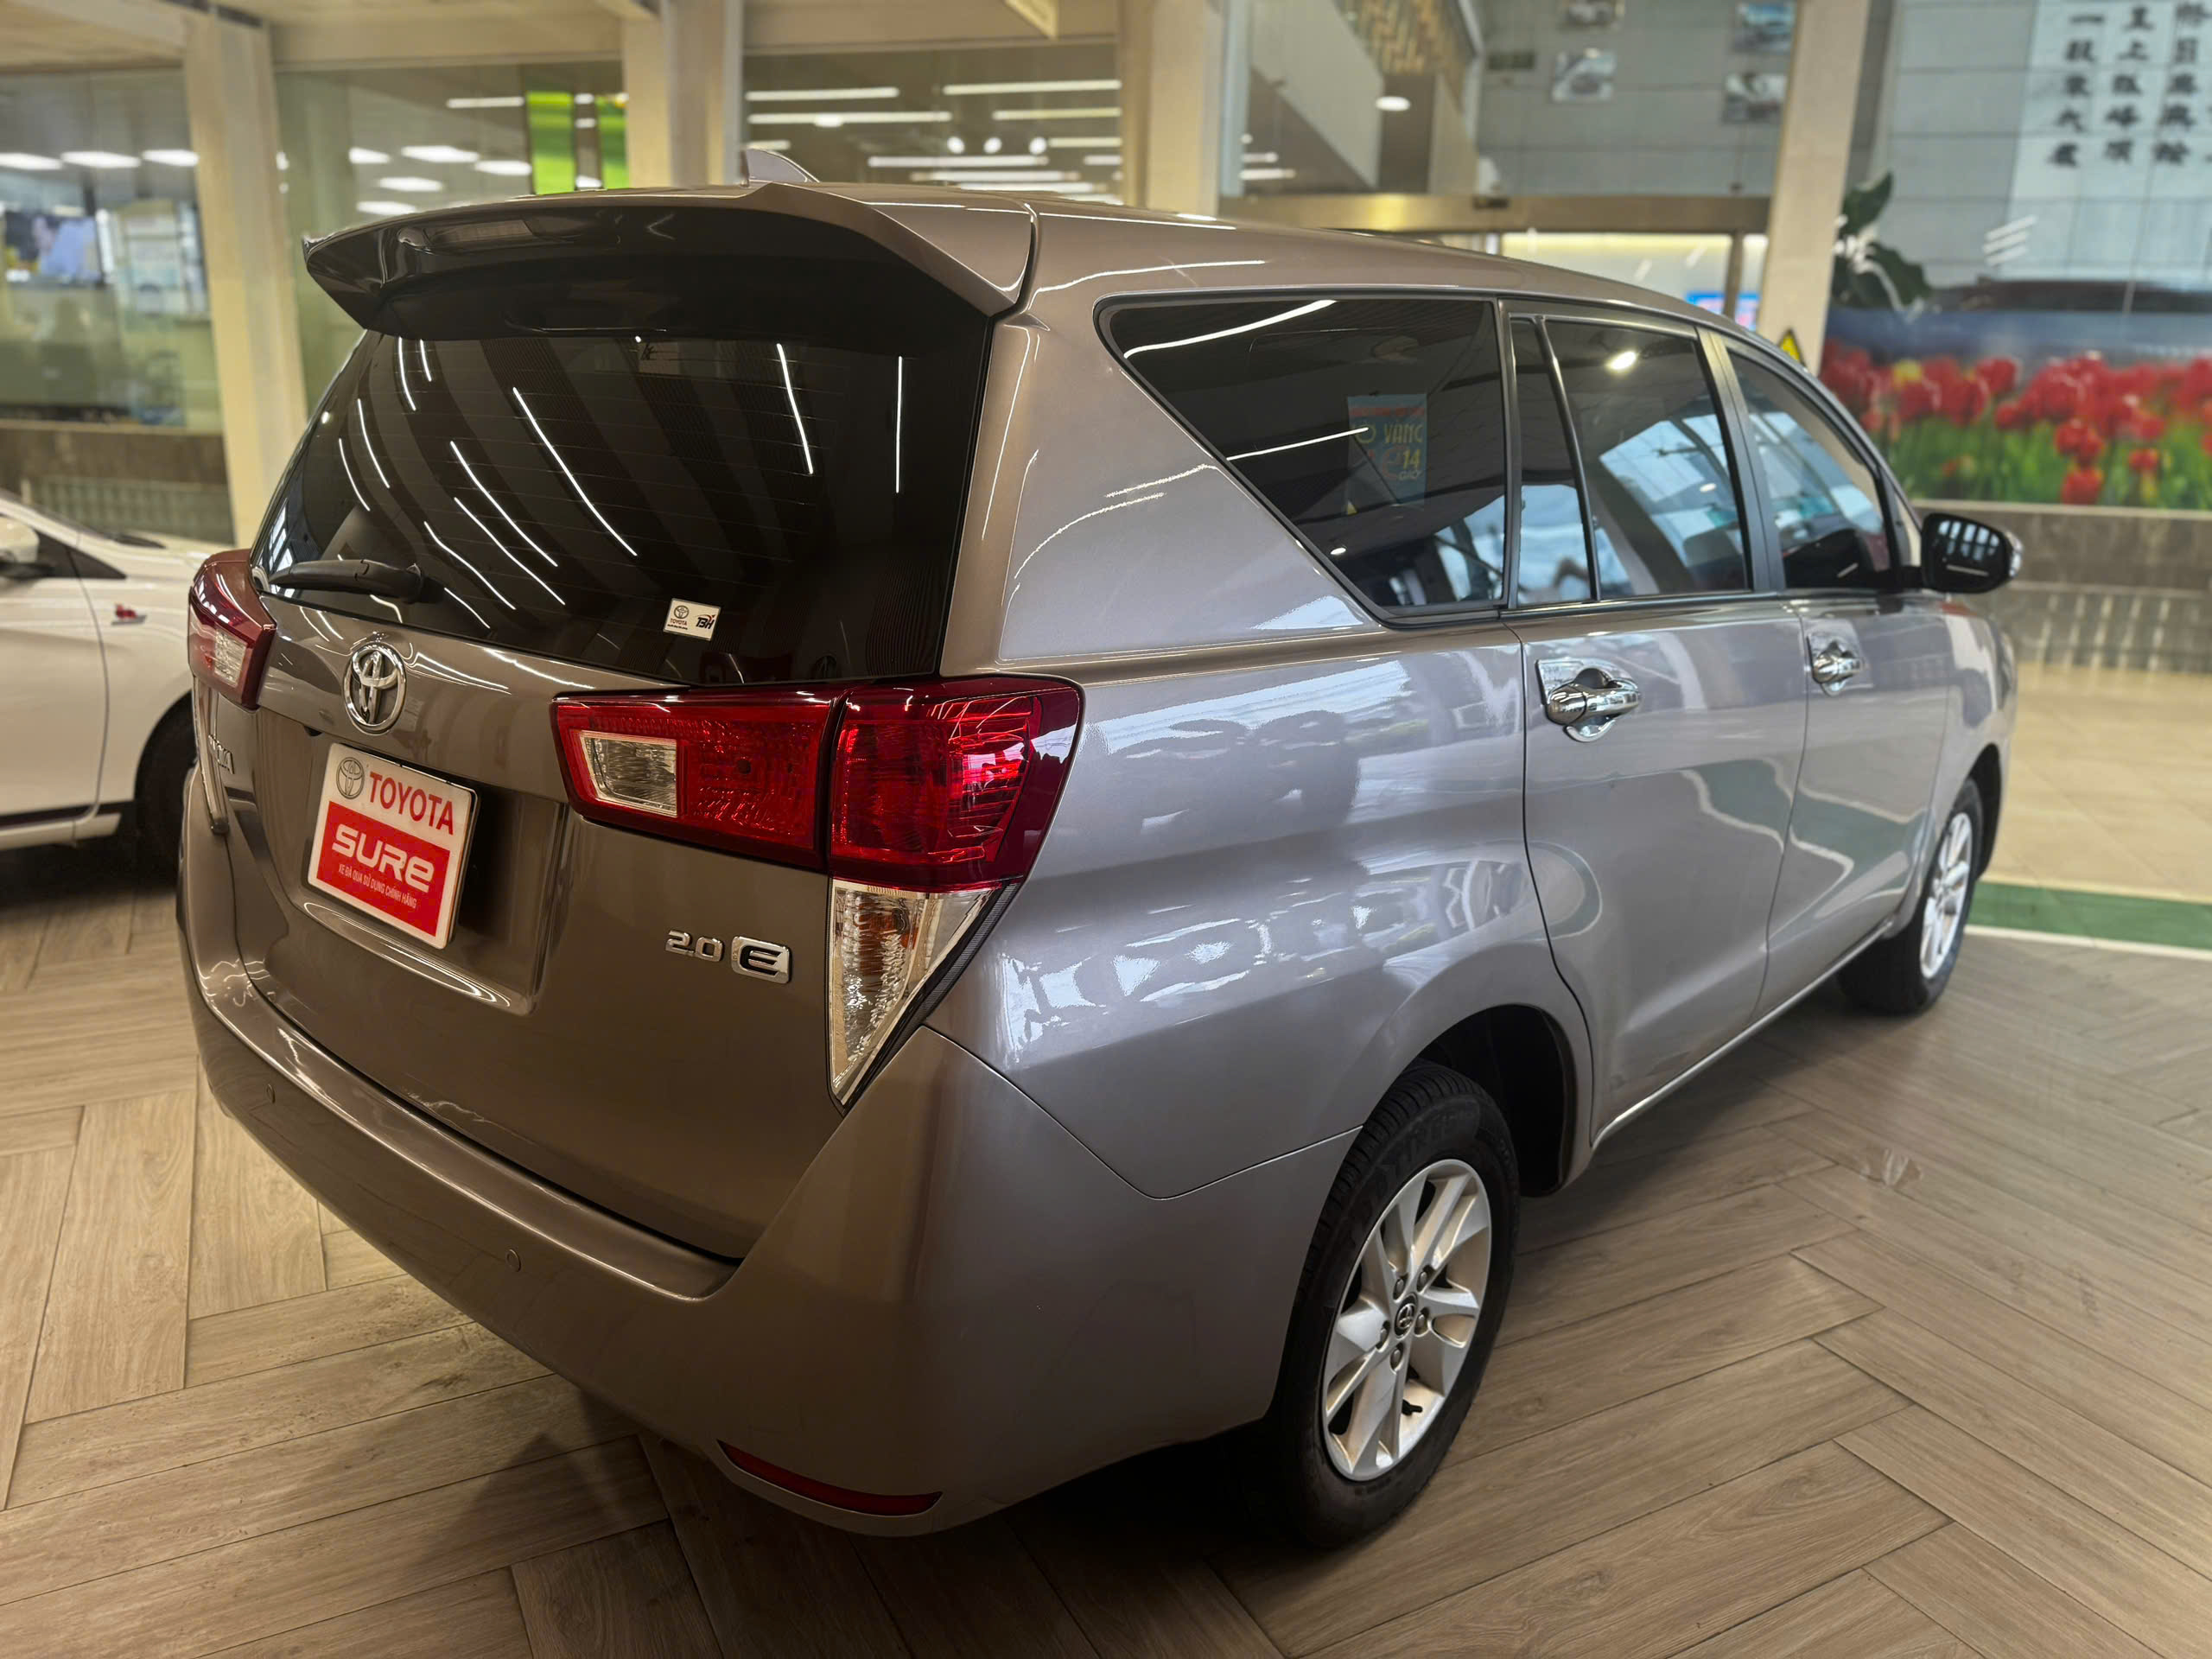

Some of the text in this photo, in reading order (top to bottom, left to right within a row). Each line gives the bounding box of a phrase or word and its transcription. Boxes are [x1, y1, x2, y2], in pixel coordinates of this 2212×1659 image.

[671, 618, 688, 626] TOYOTA
[370, 772, 454, 836] TOYOTA
[339, 863, 346, 875] XE
[353, 870, 363, 884] QUA
[665, 930, 724, 963] 2.0
